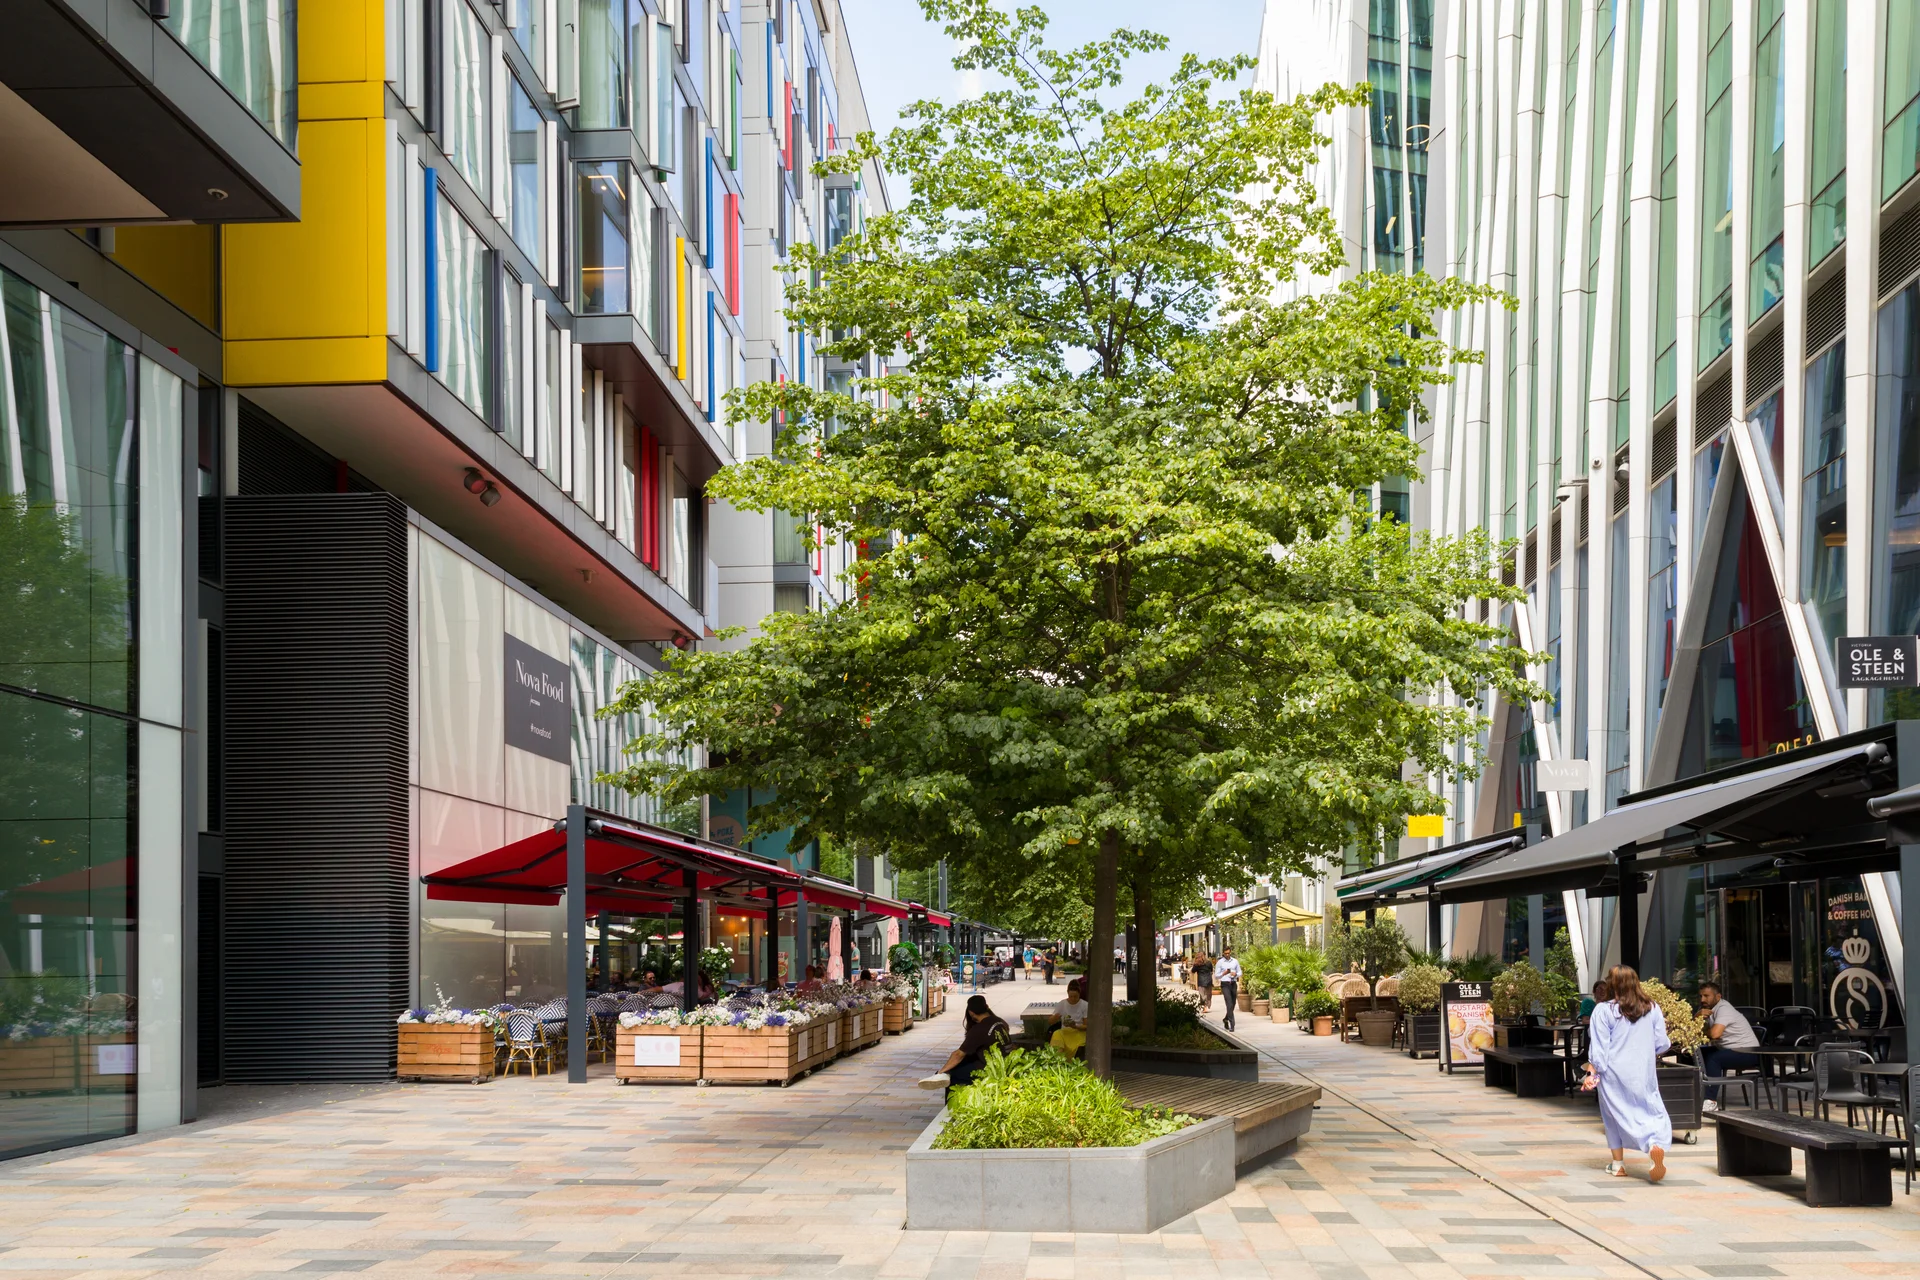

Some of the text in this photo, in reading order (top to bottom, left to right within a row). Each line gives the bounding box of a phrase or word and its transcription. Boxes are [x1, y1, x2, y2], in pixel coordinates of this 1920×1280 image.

[1850, 648, 1904, 661] OLE &
[1852, 662, 1904, 675] STEEN
[516, 659, 564, 703] Nova Food
[530, 723, 551, 740] #novafood
[1543, 763, 1579, 777] Nova
[717, 826, 734, 836] POKE
[1828, 893, 1853, 907] DANISH
[1828, 909, 1873, 920] & COFFEE HO
